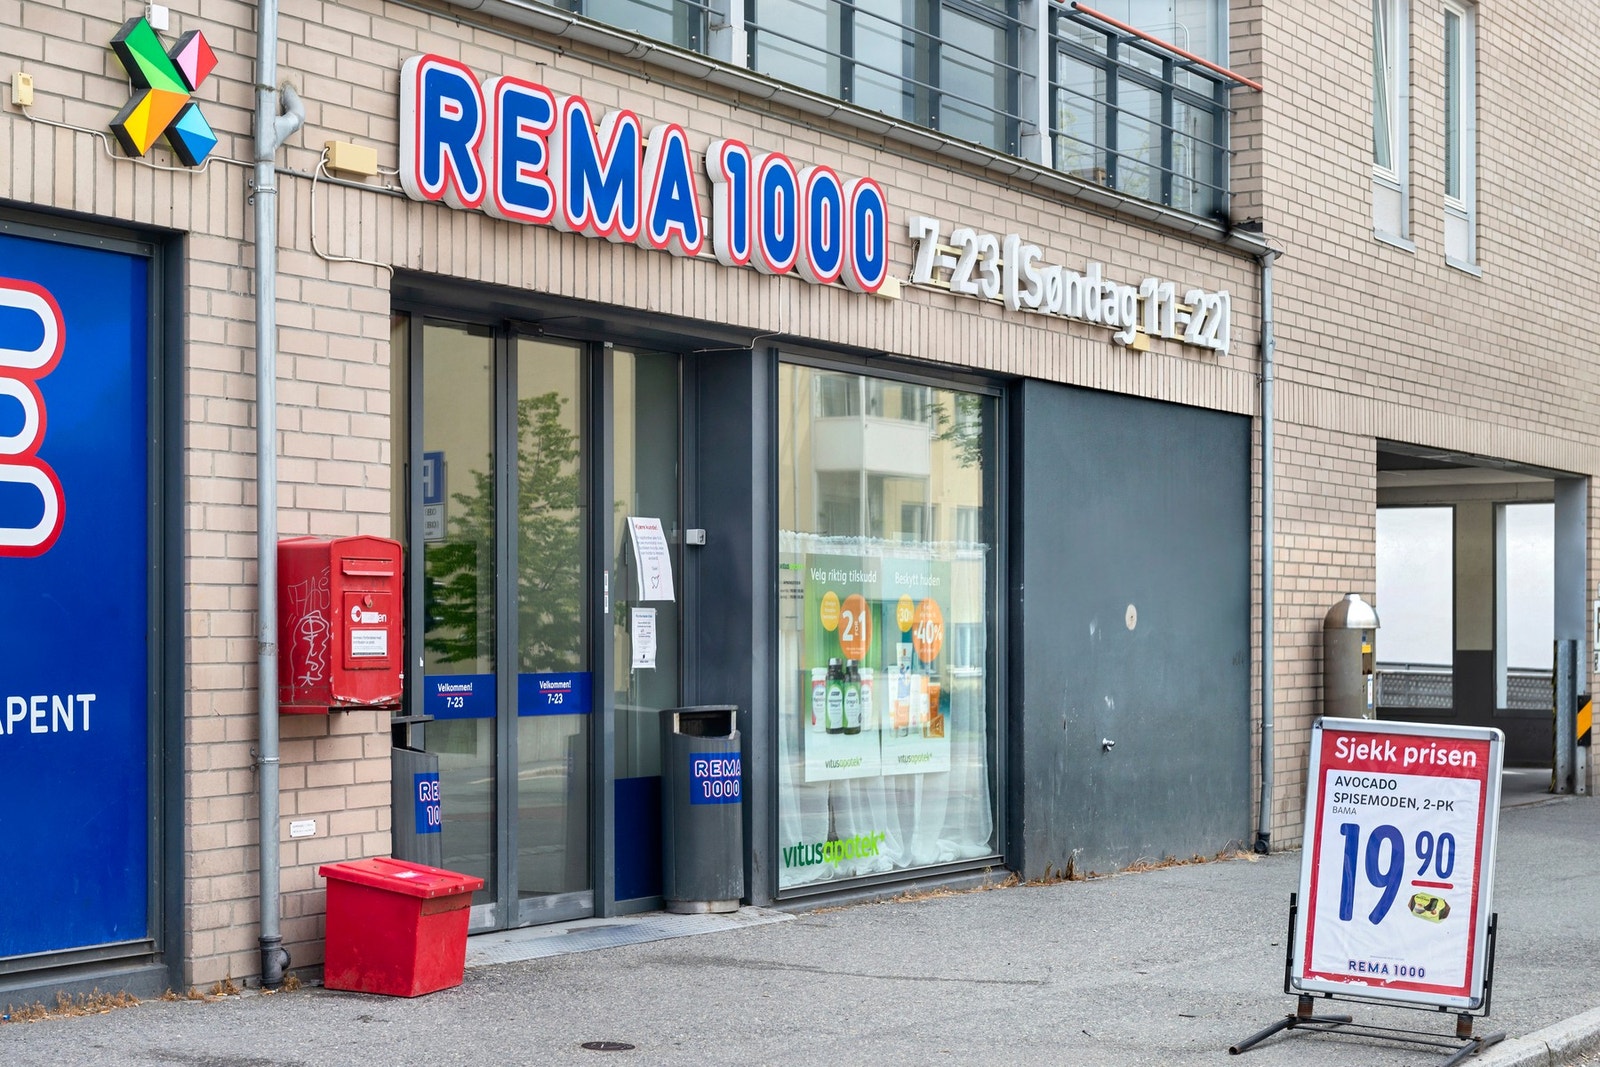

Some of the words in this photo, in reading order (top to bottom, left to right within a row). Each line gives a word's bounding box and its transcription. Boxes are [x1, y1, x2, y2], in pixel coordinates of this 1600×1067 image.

[412, 54, 704, 257] REMA
[716, 138, 889, 293] 1000
[909, 216, 1000, 299] 7-23
[810, 568, 826, 584] Velg
[828, 569, 847, 585] riktig
[849, 570, 877, 583] tilskudd
[895, 572, 919, 588] Beskytt
[920, 574, 940, 586] huden
[842, 610, 854, 641] 2
[858, 610, 866, 641] 1
[437, 682, 473, 693] Velkommen!
[539, 679, 572, 690] Velkommen!
[446, 697, 464, 708] 7-23
[547, 693, 563, 704] 7-23
[0, 694, 96, 735] PENT
[1334, 736, 1397, 763] Sjekk
[1402, 742, 1477, 768] prisen
[694, 758, 741, 777] REMA
[419, 781, 441, 801] RE
[702, 779, 740, 798] 1000
[1335, 775, 1398, 791] AVOCADO
[1332, 805, 1357, 816] BAMA
[1333, 791, 1420, 811] SPISEMODEN,
[1422, 798, 1454, 812] 2-PK
[783, 830, 880, 869] vitusapotek
[1338, 822, 1405, 926] 19
[1414, 830, 1456, 879] 90
[1348, 960, 1389, 975] REMA
[1393, 965, 1425, 978] 1000
